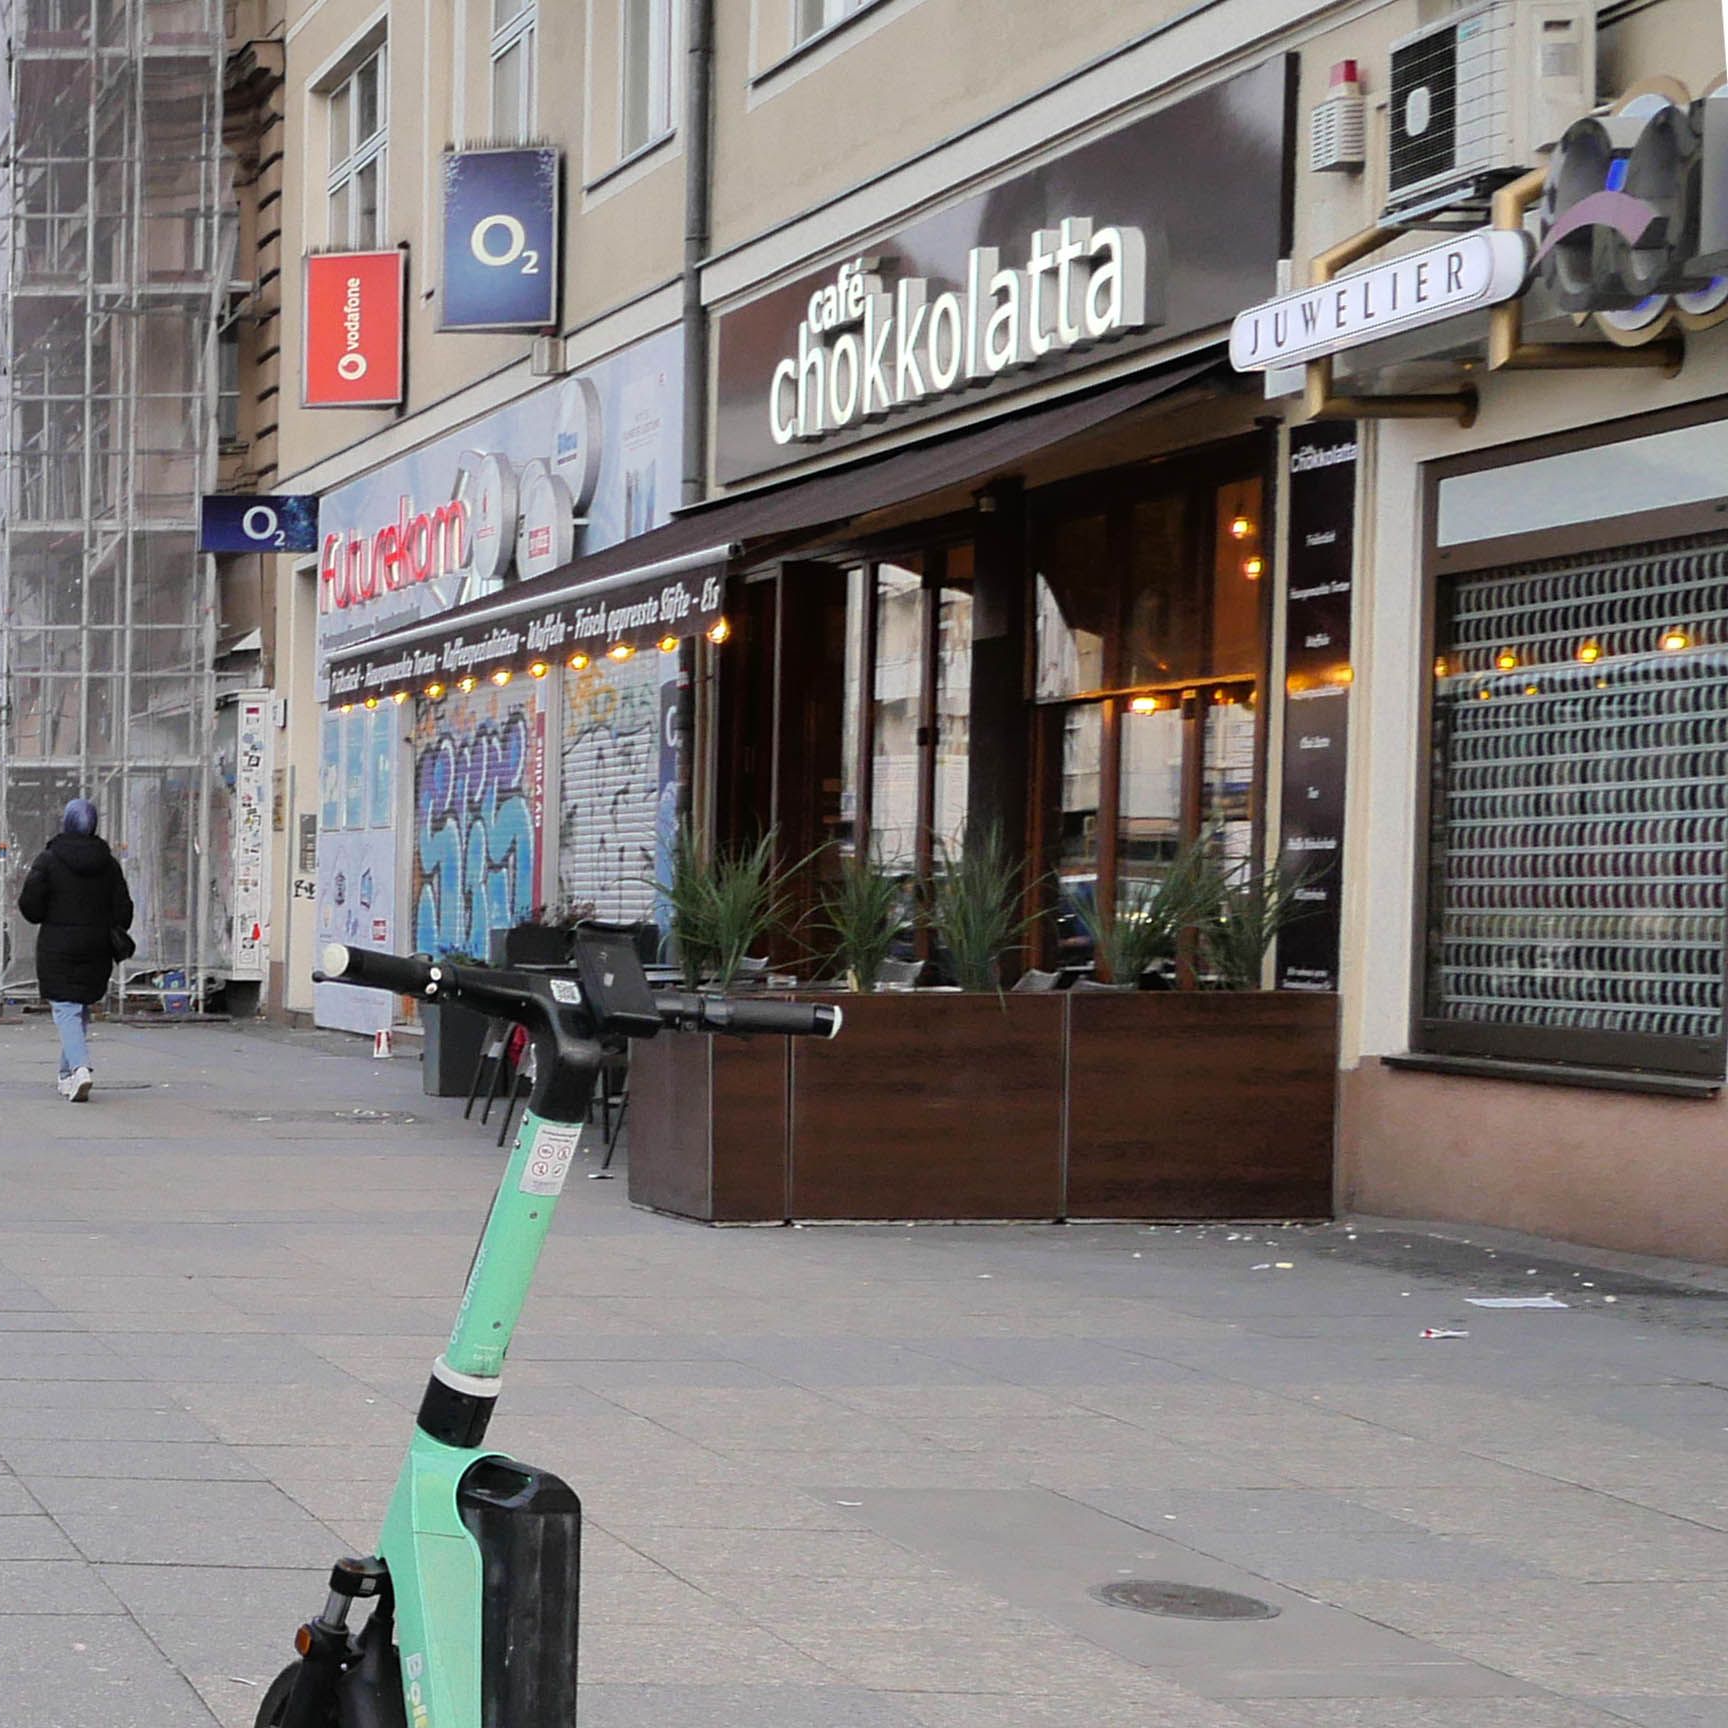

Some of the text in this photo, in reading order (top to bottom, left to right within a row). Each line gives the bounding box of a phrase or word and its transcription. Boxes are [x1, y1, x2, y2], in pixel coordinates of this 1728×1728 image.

[346, 277, 361, 350] vodafone
[769, 218, 1139, 445] chokkolatta
[808, 258, 865, 334] café
[1251, 251, 1463, 357] JUWELIER
[320, 495, 466, 614] futurekom
[575, 602, 606, 639] Frisch
[607, 594, 658, 642] gepresste
[659, 585, 690, 625] Säfte
